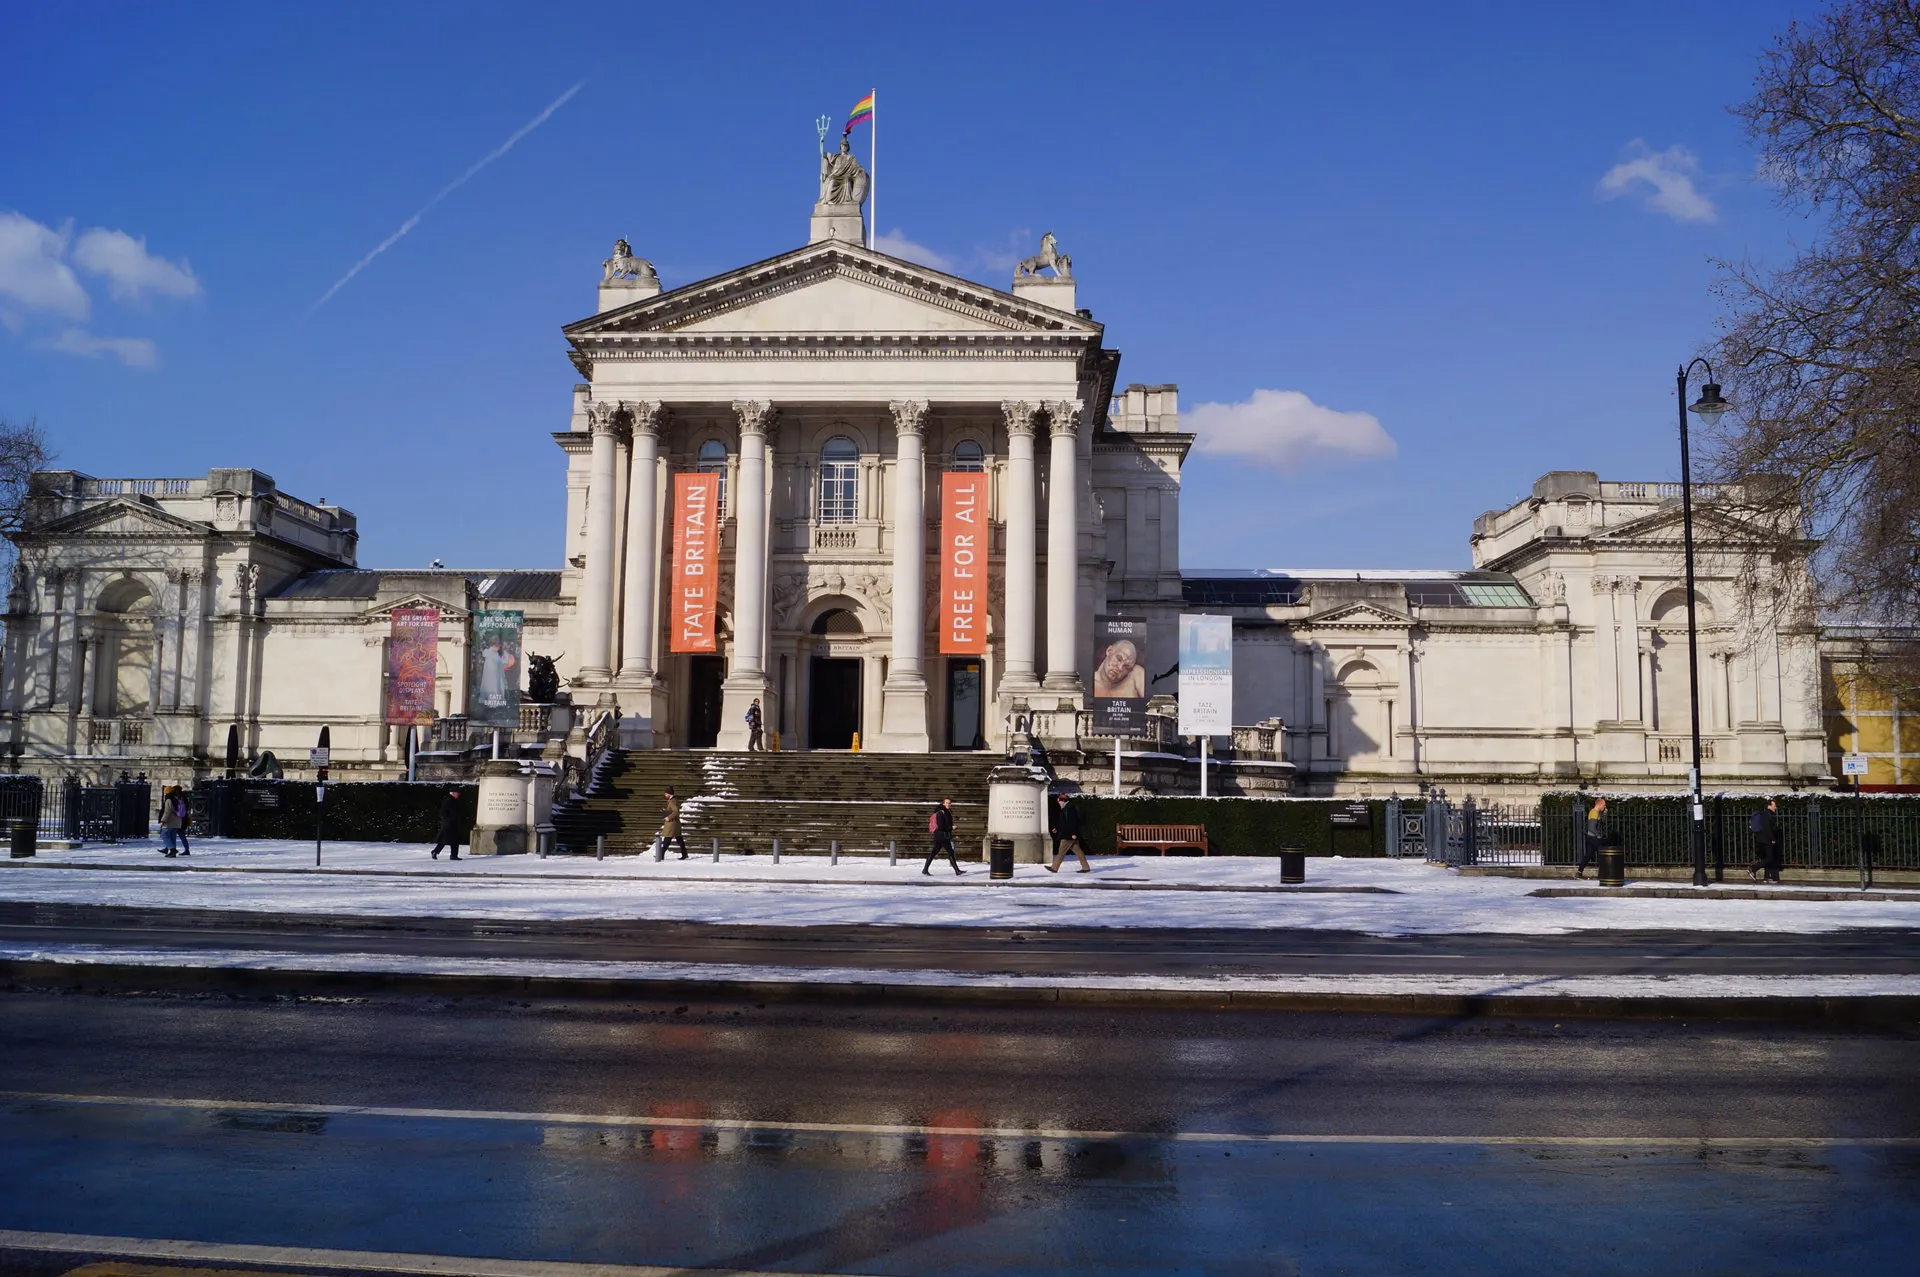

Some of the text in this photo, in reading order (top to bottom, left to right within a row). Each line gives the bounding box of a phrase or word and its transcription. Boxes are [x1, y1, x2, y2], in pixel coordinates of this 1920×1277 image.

[683, 486, 706, 640] TATE BRITAIN
[954, 484, 975, 642] FREE FOR ALL
